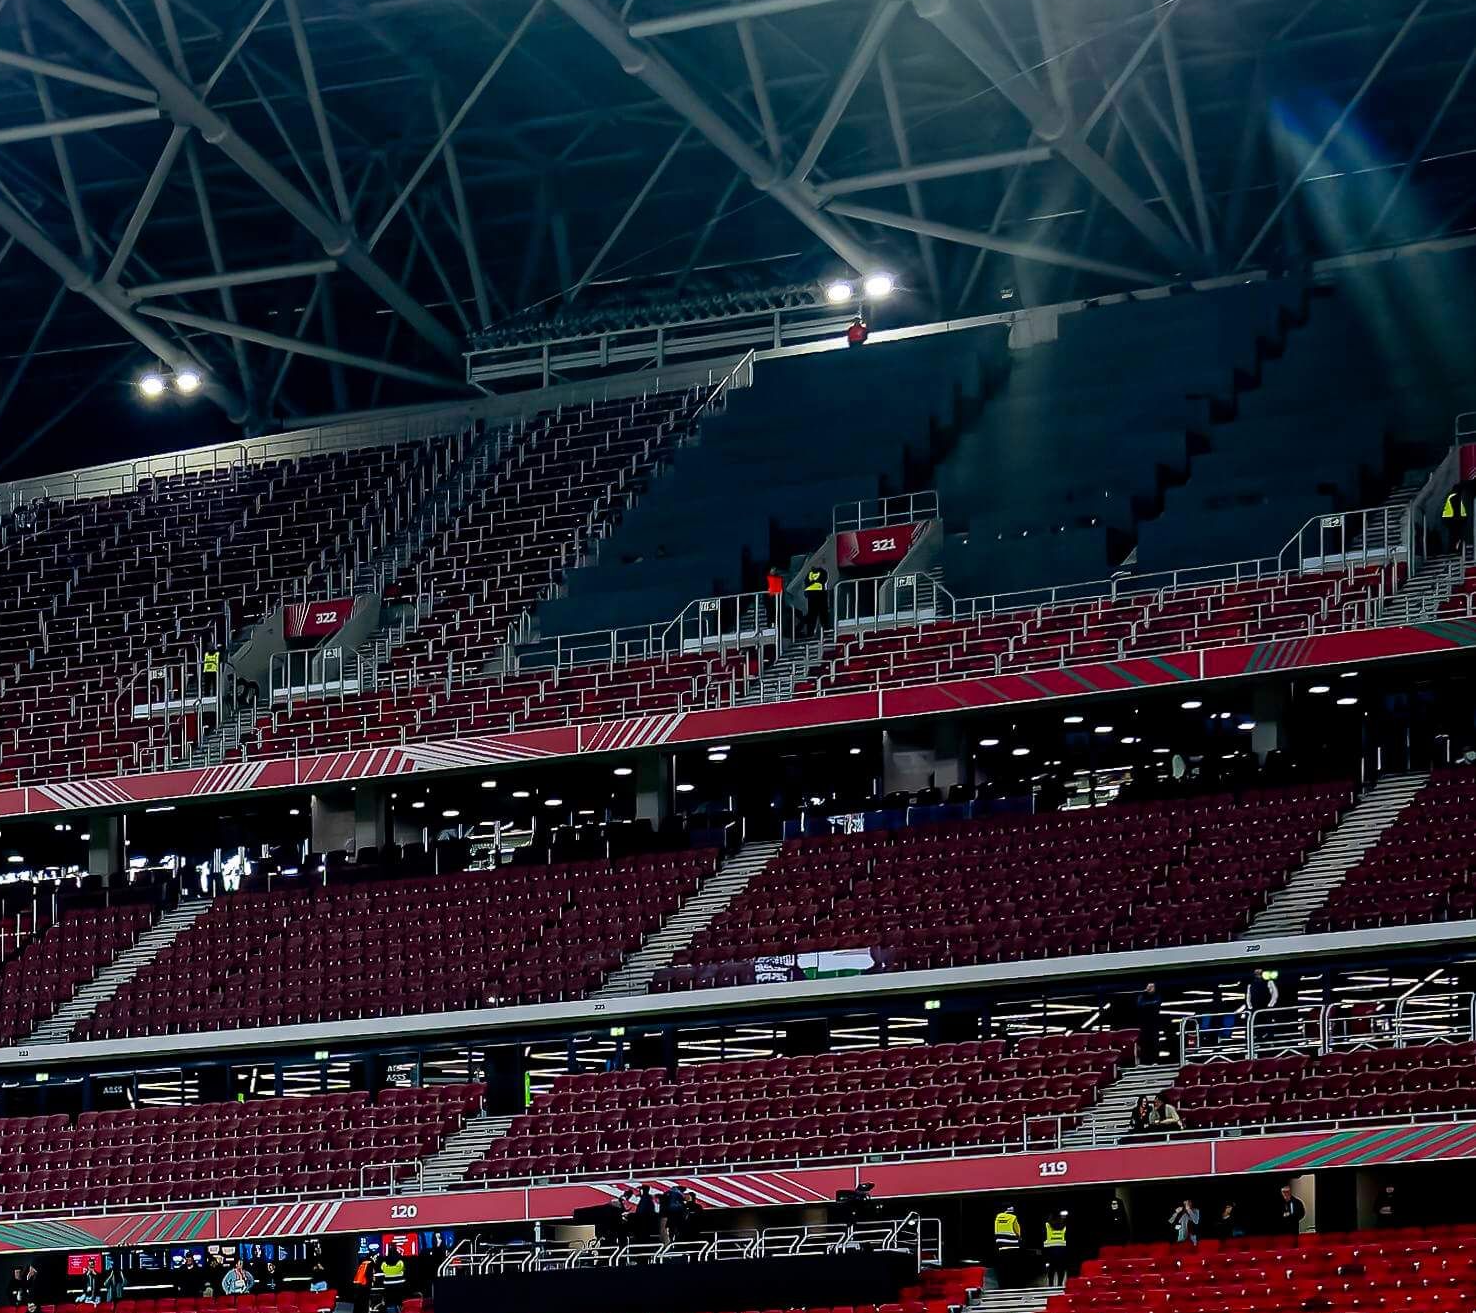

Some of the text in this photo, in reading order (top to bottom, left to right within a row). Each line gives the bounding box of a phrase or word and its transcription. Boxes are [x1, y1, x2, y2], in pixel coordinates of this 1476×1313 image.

[872, 539, 896, 551] 321
[315, 612, 337, 624] 322
[1039, 1162, 1068, 1176] 119
[391, 1205, 417, 1218] 120
